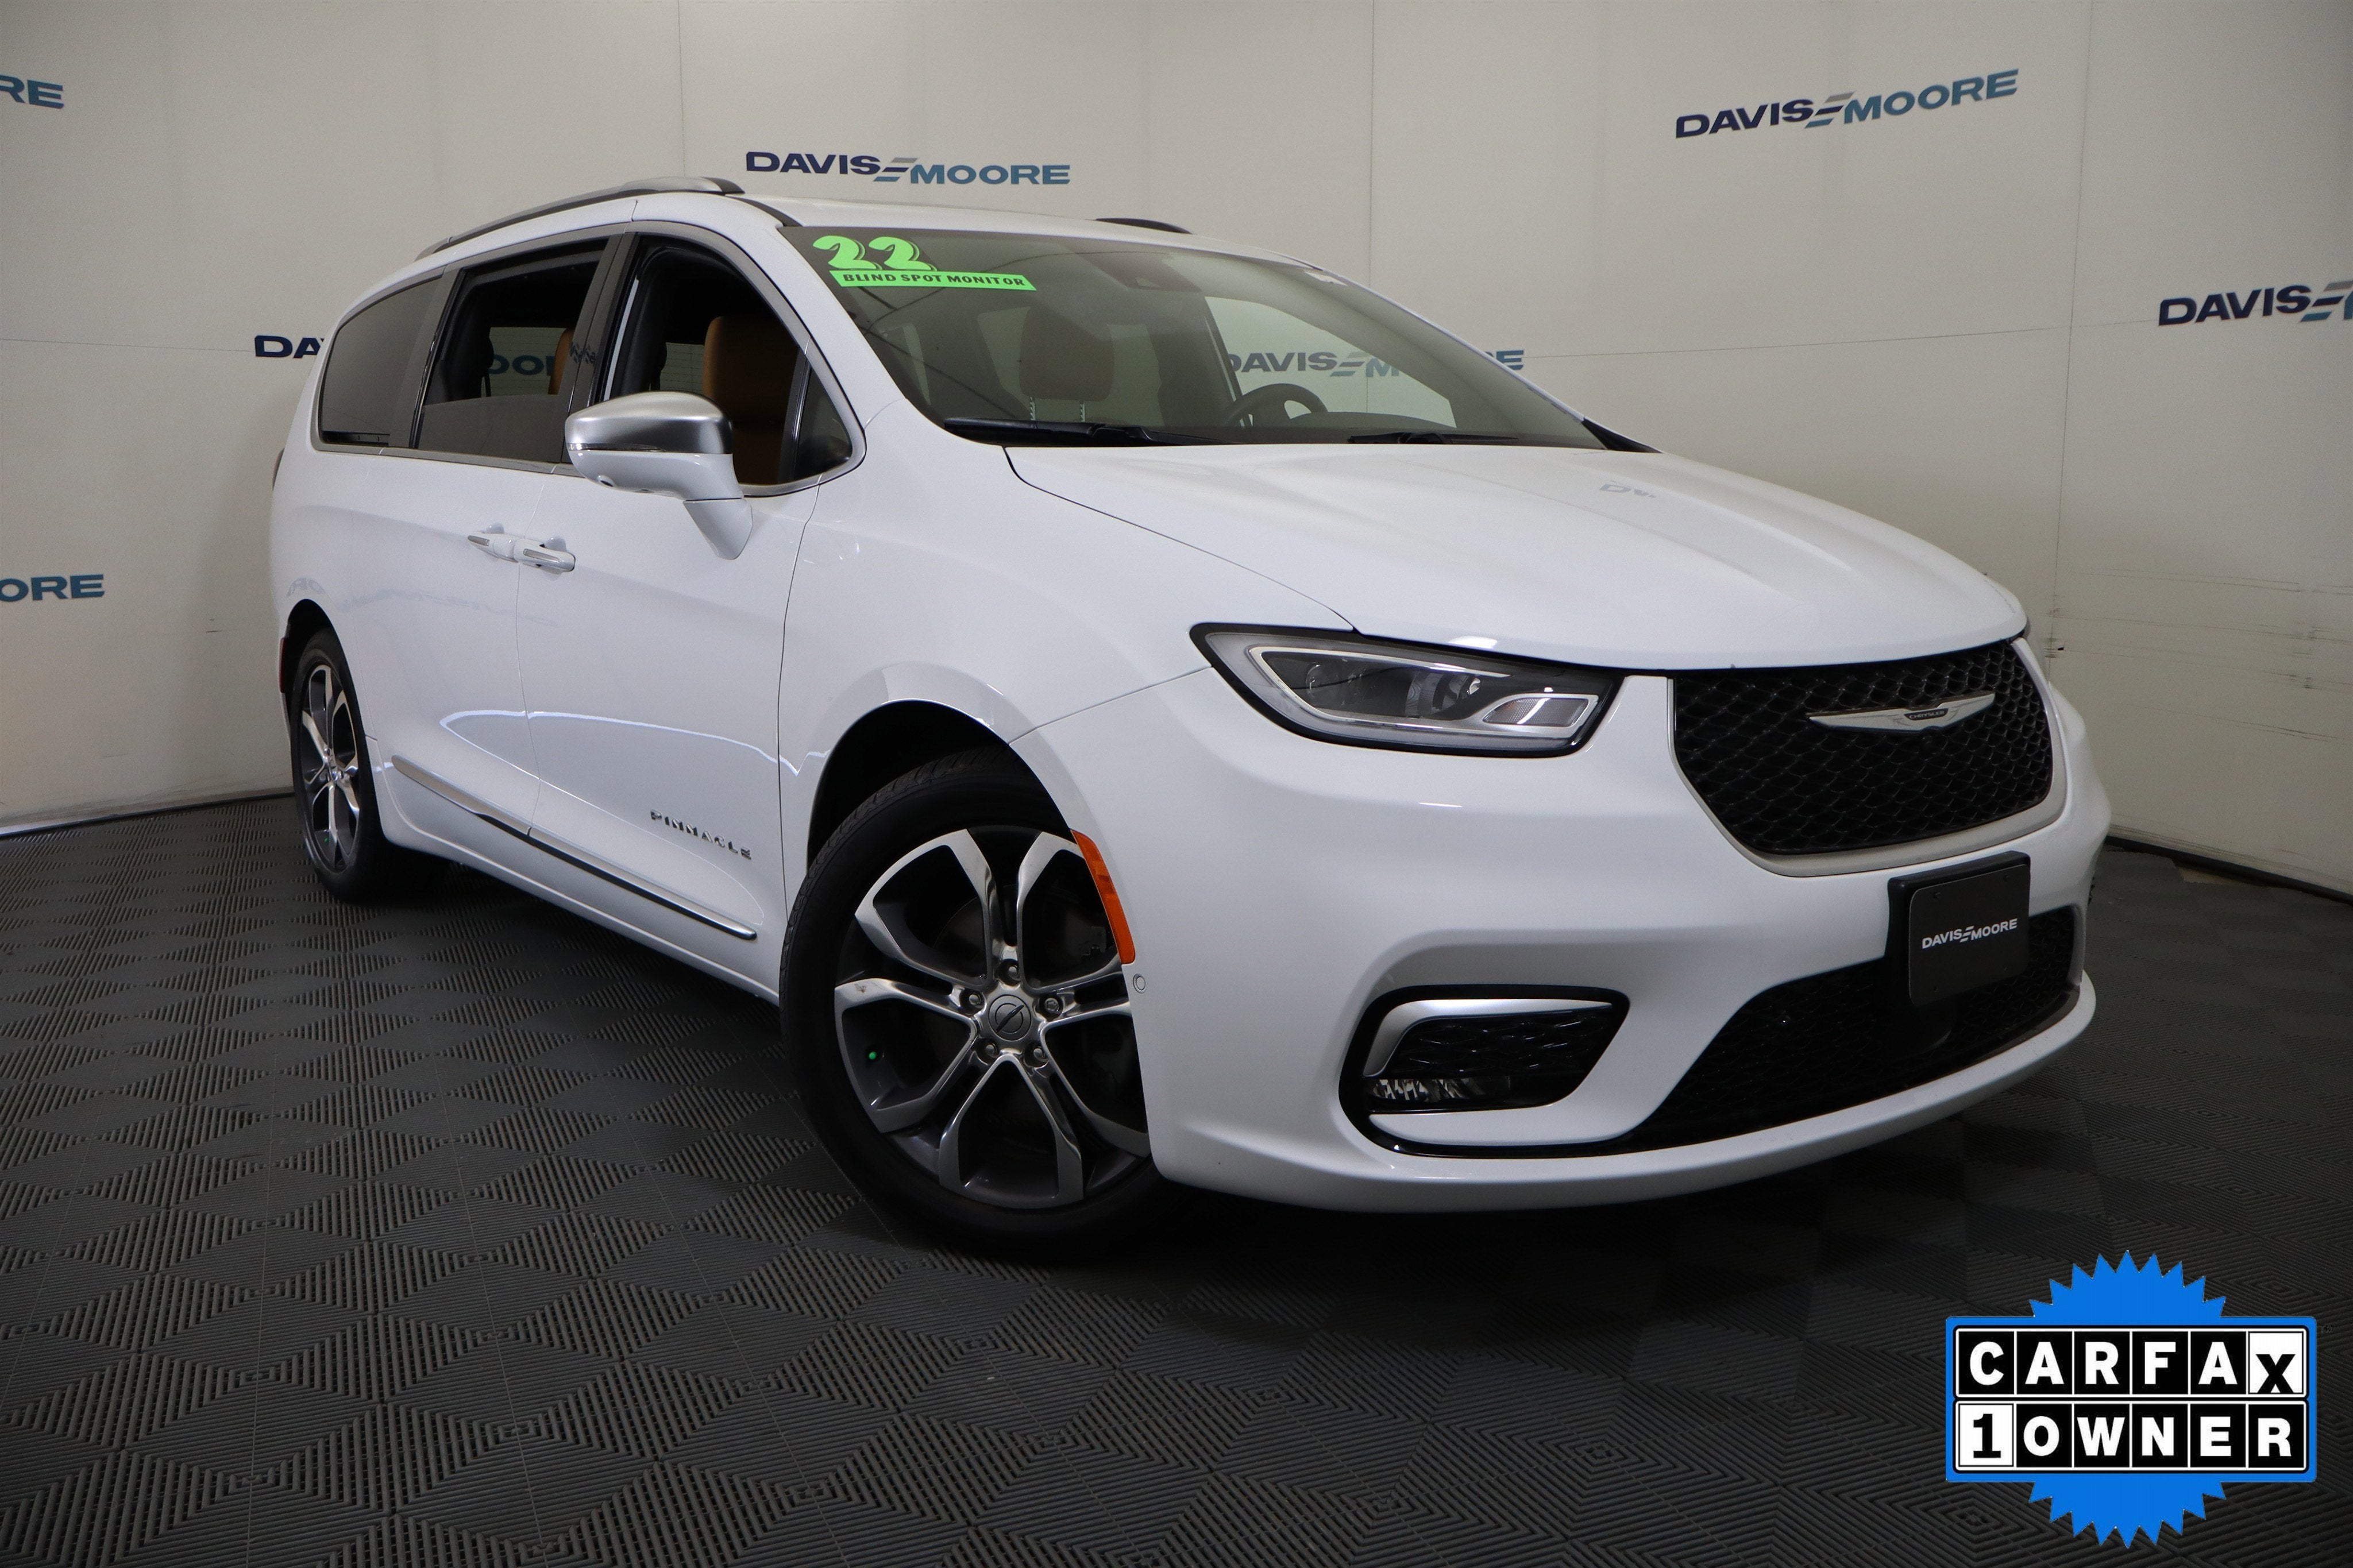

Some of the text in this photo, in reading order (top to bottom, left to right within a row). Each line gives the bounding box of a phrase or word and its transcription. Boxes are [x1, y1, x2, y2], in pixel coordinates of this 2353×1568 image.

[1676, 69, 2019, 138] DAVIS MOORE
[746, 152, 1070, 184] DAVIS MOORE
[812, 235, 937, 271] 22
[843, 273, 1026, 286] BLIND SPOT MONITOR
[2159, 285, 2311, 326] DAVIS
[254, 335, 323, 358] DA
[1909, 710, 1945, 719] CHRYSLER
[650, 809, 752, 860] PINNACLE
[1922, 918, 2018, 949] DAVIS MOORE
